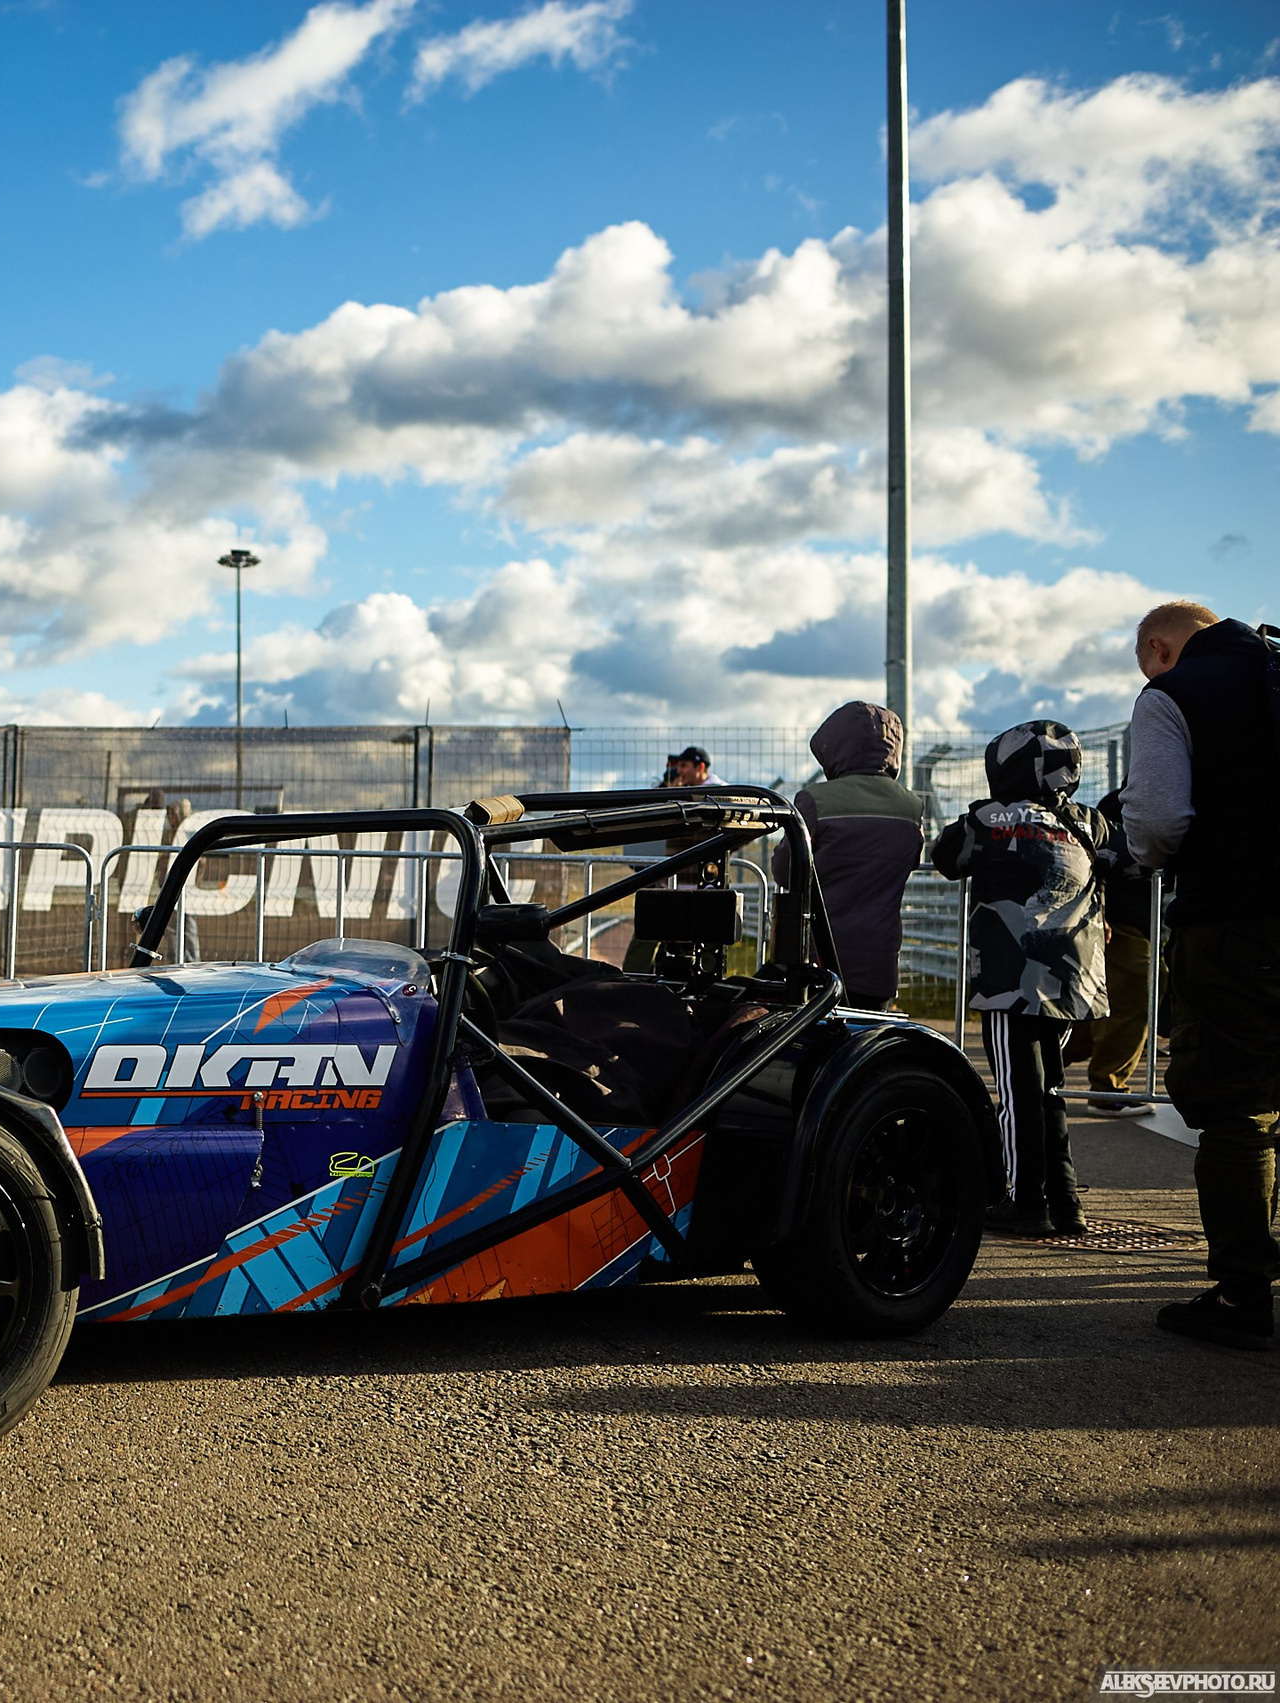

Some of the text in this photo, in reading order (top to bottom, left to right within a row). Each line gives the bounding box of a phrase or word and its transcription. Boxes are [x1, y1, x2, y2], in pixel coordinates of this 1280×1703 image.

[989, 812, 1014, 823] SAY
[1017, 808, 1054, 826] YES
[990, 825, 1079, 846] CHALLENG
[240, 1088, 383, 1110] RACING
